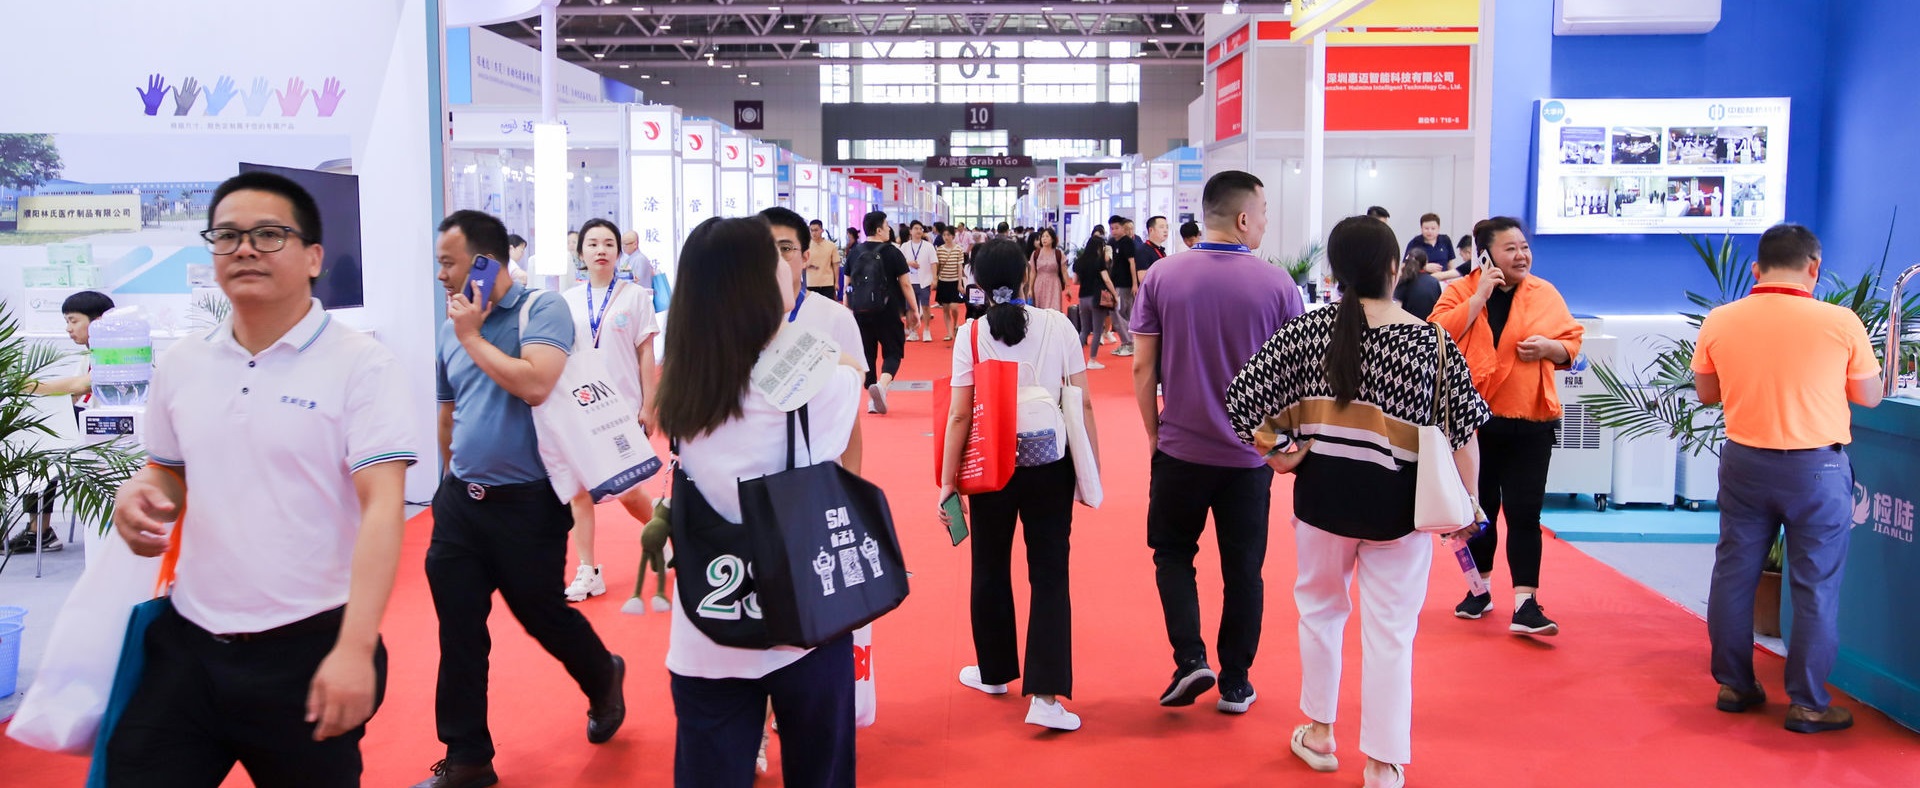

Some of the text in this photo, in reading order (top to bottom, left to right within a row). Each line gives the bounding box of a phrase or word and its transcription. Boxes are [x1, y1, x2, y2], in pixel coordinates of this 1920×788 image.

[970, 107, 989, 124] 10
[969, 157, 994, 166] Grab
[1004, 157, 1018, 166] Go
[1873, 492, 1915, 531] 检陆
[1873, 522, 1913, 542] JIANLU
